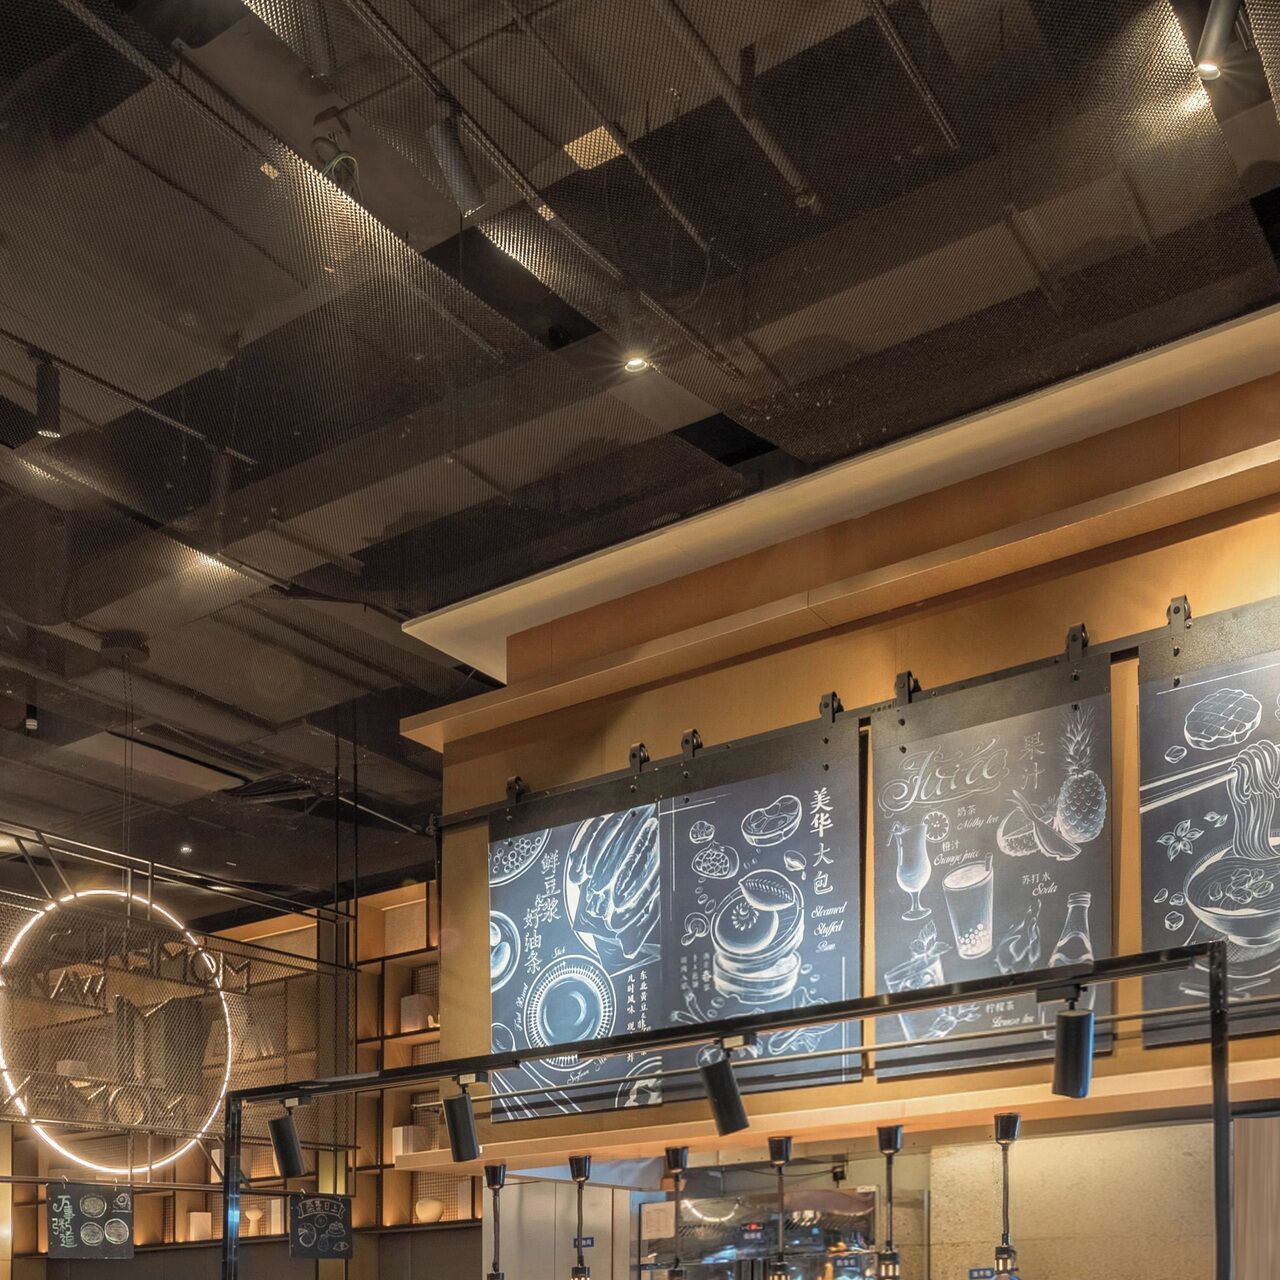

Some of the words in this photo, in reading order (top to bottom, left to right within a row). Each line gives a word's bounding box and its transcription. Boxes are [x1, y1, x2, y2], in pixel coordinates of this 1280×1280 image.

[1019, 732, 1046, 790] 果汁
[809, 786, 834, 895] 美华大包
[540, 850, 561, 923] 鲜豆浆
[1032, 881, 1058, 897] Soda
[523, 908, 543, 975] 好油条
